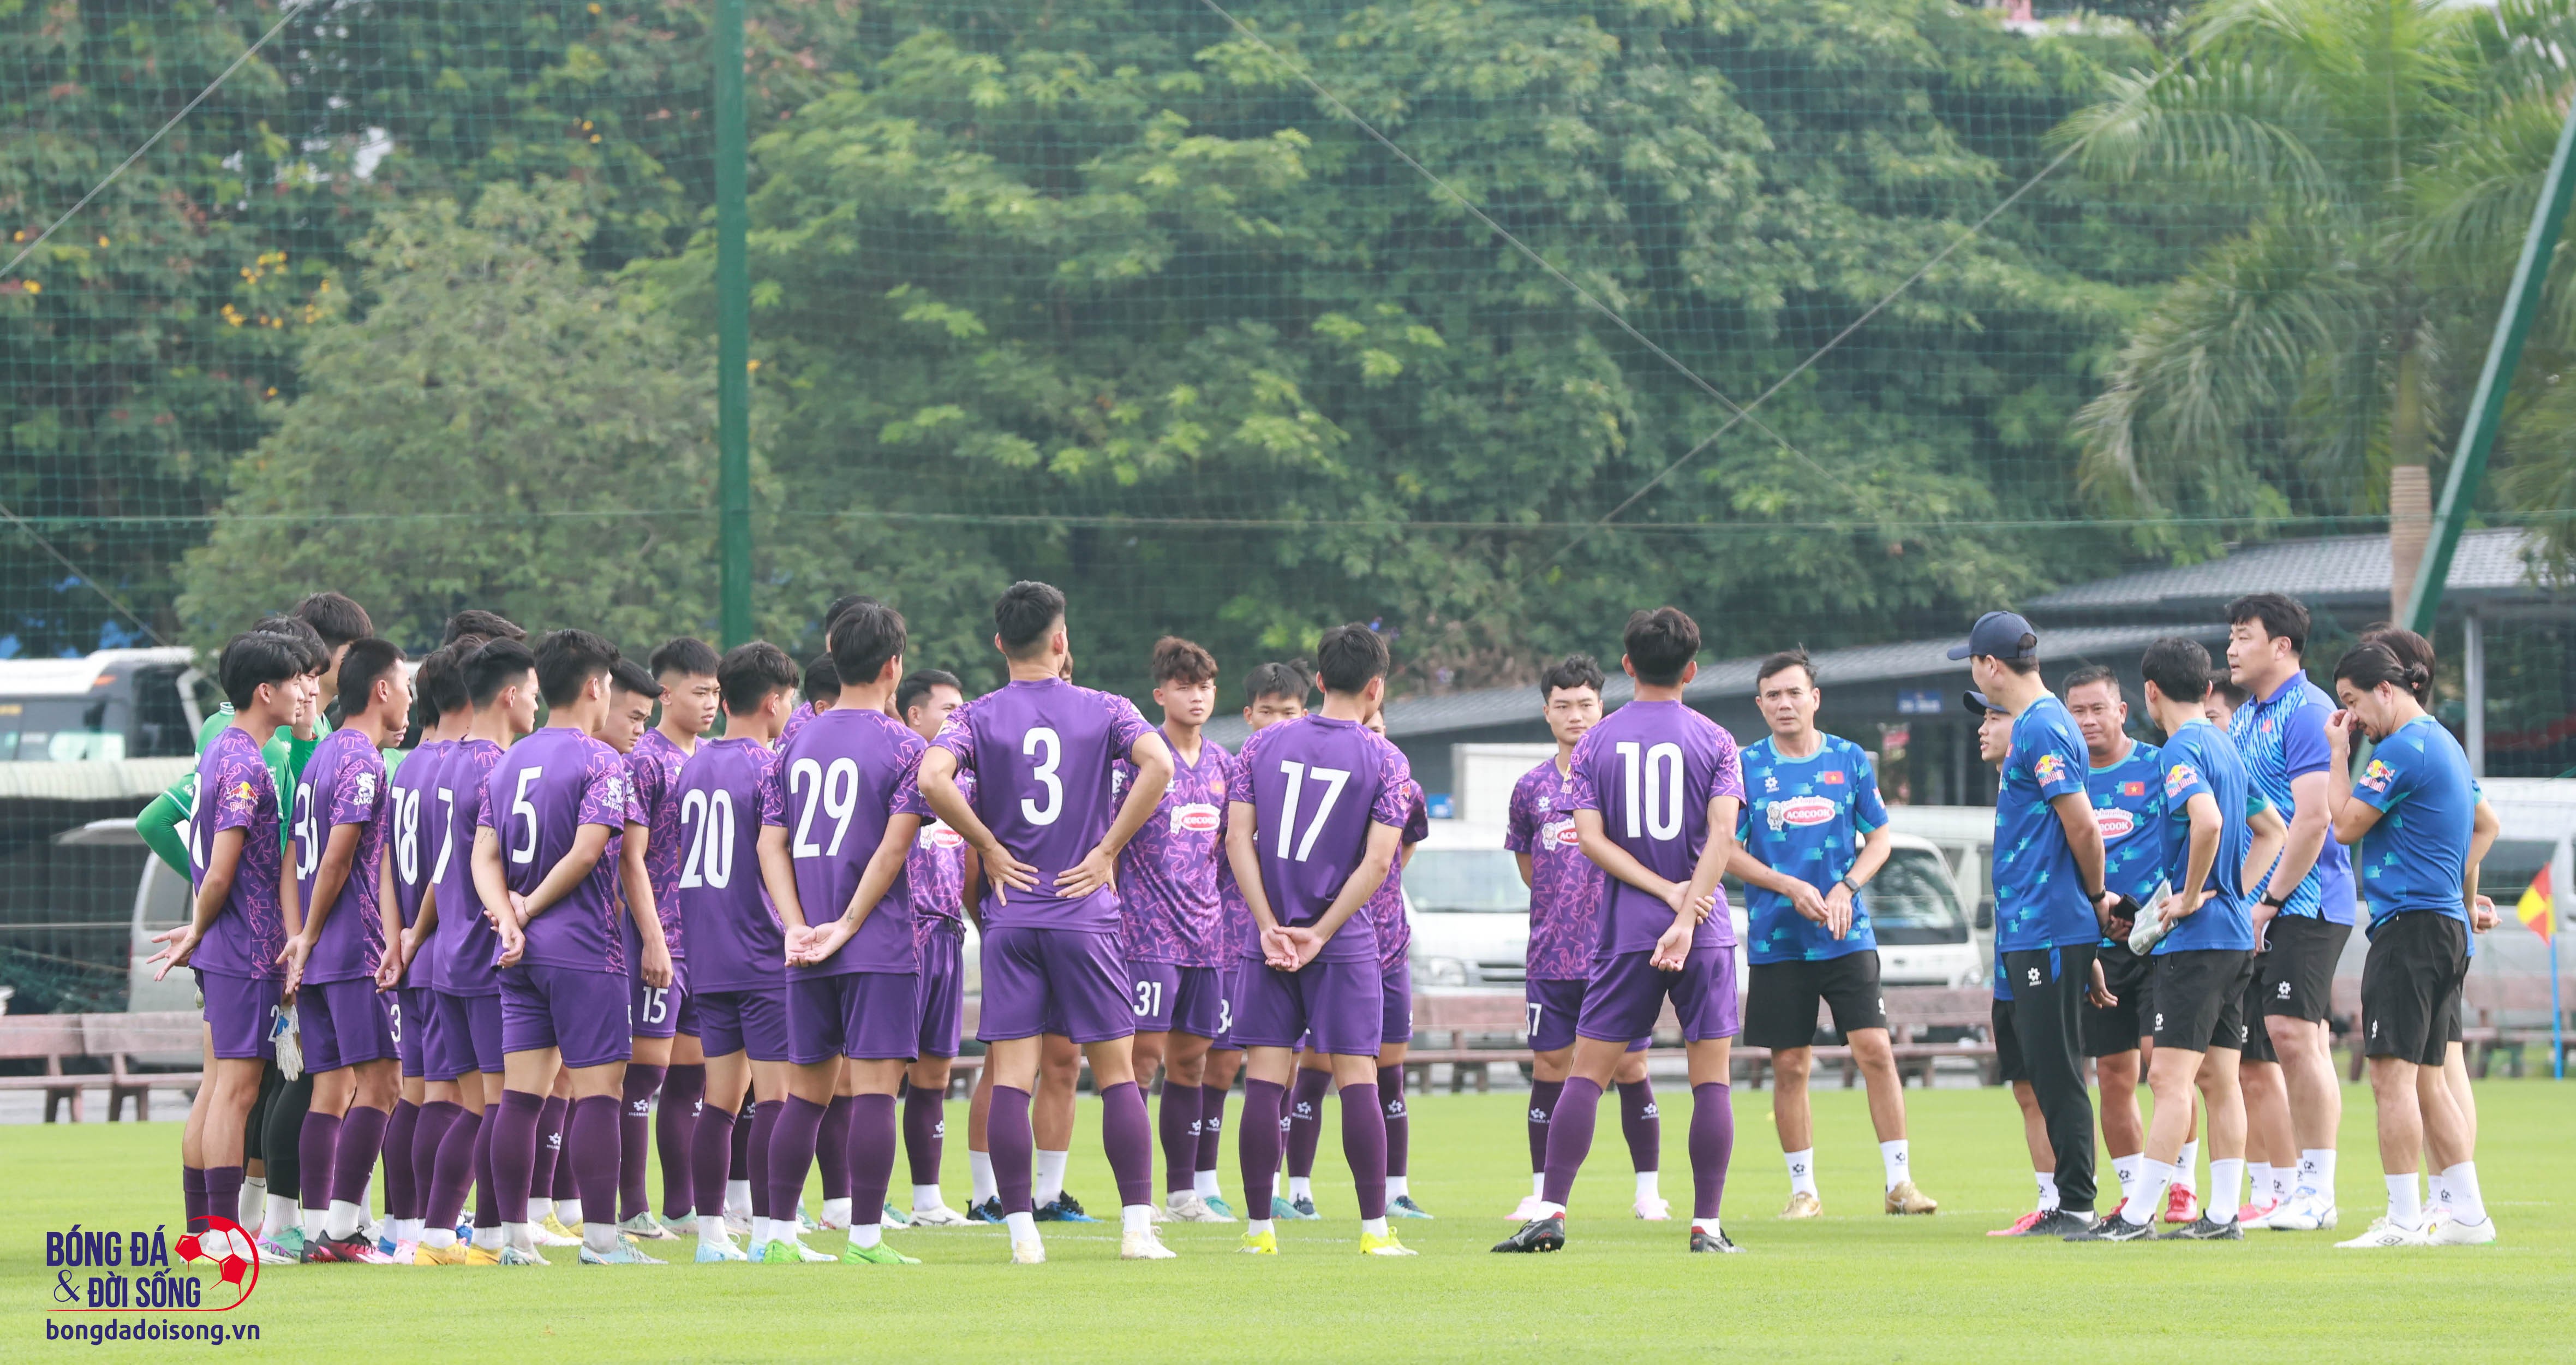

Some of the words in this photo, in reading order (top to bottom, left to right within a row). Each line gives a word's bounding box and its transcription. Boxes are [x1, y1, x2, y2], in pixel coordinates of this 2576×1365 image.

[512, 766, 542, 863] 5
[790, 758, 858, 859] 29
[1021, 728, 1062, 825] 3
[1277, 760, 1351, 862] 17
[1616, 742, 1684, 841] 10
[391, 786, 420, 885] 18
[432, 786, 453, 885] 7
[679, 789, 734, 889] 20
[642, 986, 668, 1024] 15
[1133, 981, 1162, 1017] 31
